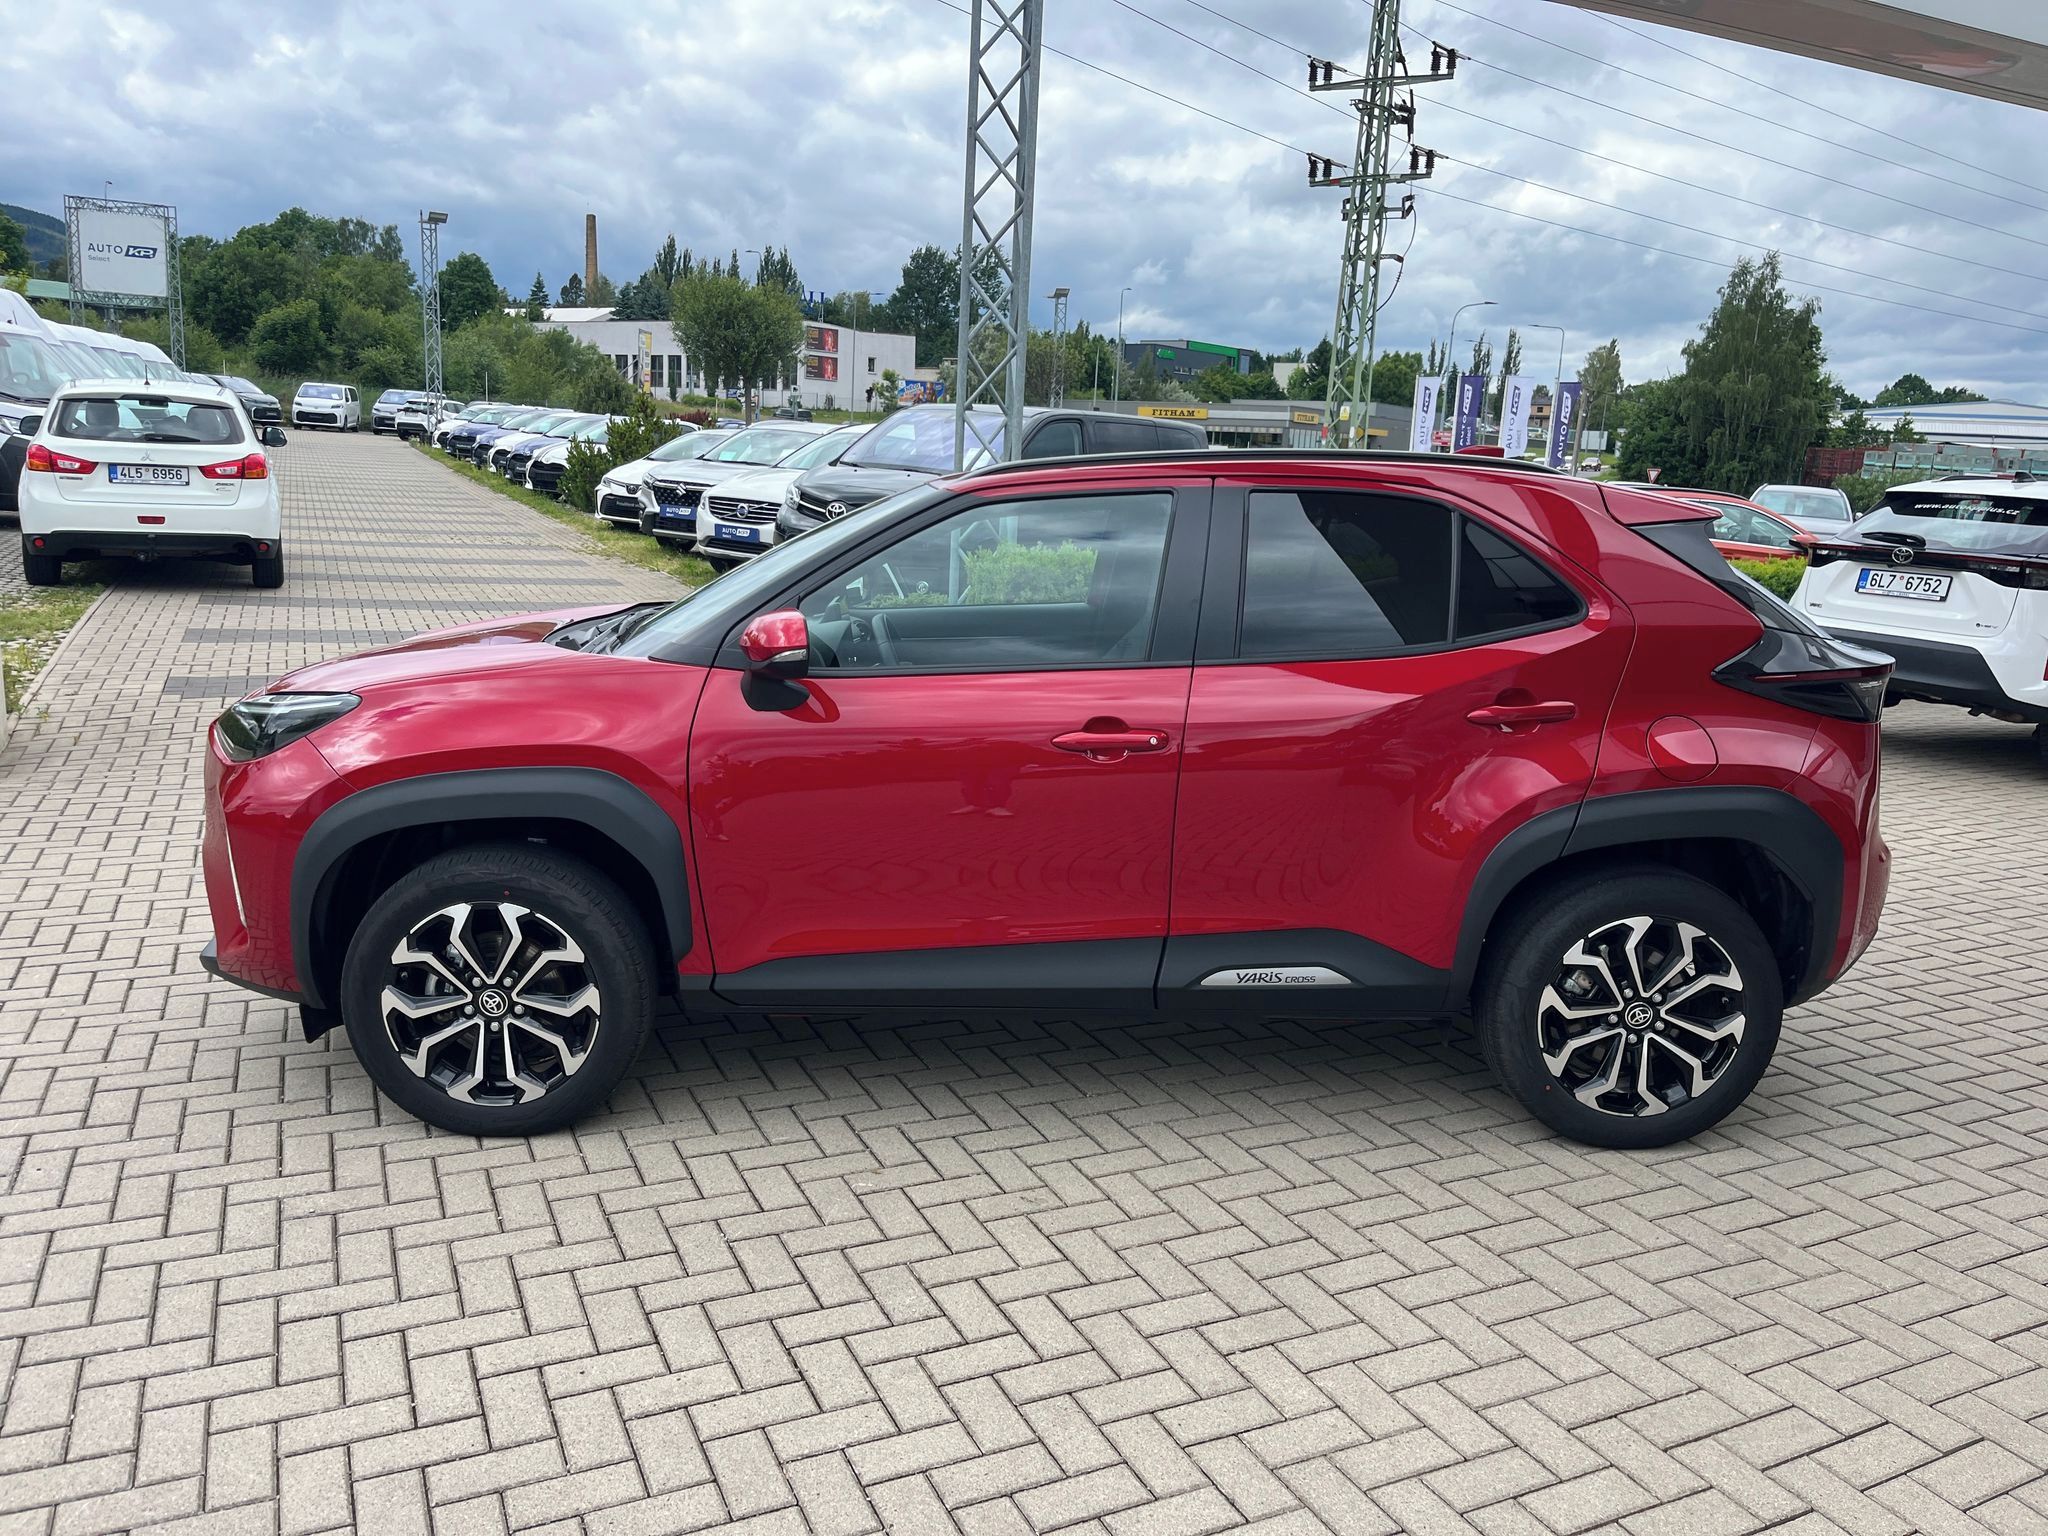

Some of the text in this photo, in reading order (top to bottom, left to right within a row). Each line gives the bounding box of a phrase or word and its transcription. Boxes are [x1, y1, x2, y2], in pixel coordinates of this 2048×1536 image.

[88, 243, 122, 254] AUTO
[1152, 408, 1195, 417] FITHAM
[1506, 418, 1515, 449] AUTO
[1557, 425, 1567, 458] AUTO
[120, 467, 182, 480] 4L5 6956
[1870, 573, 1942, 593] 6L7 6752
